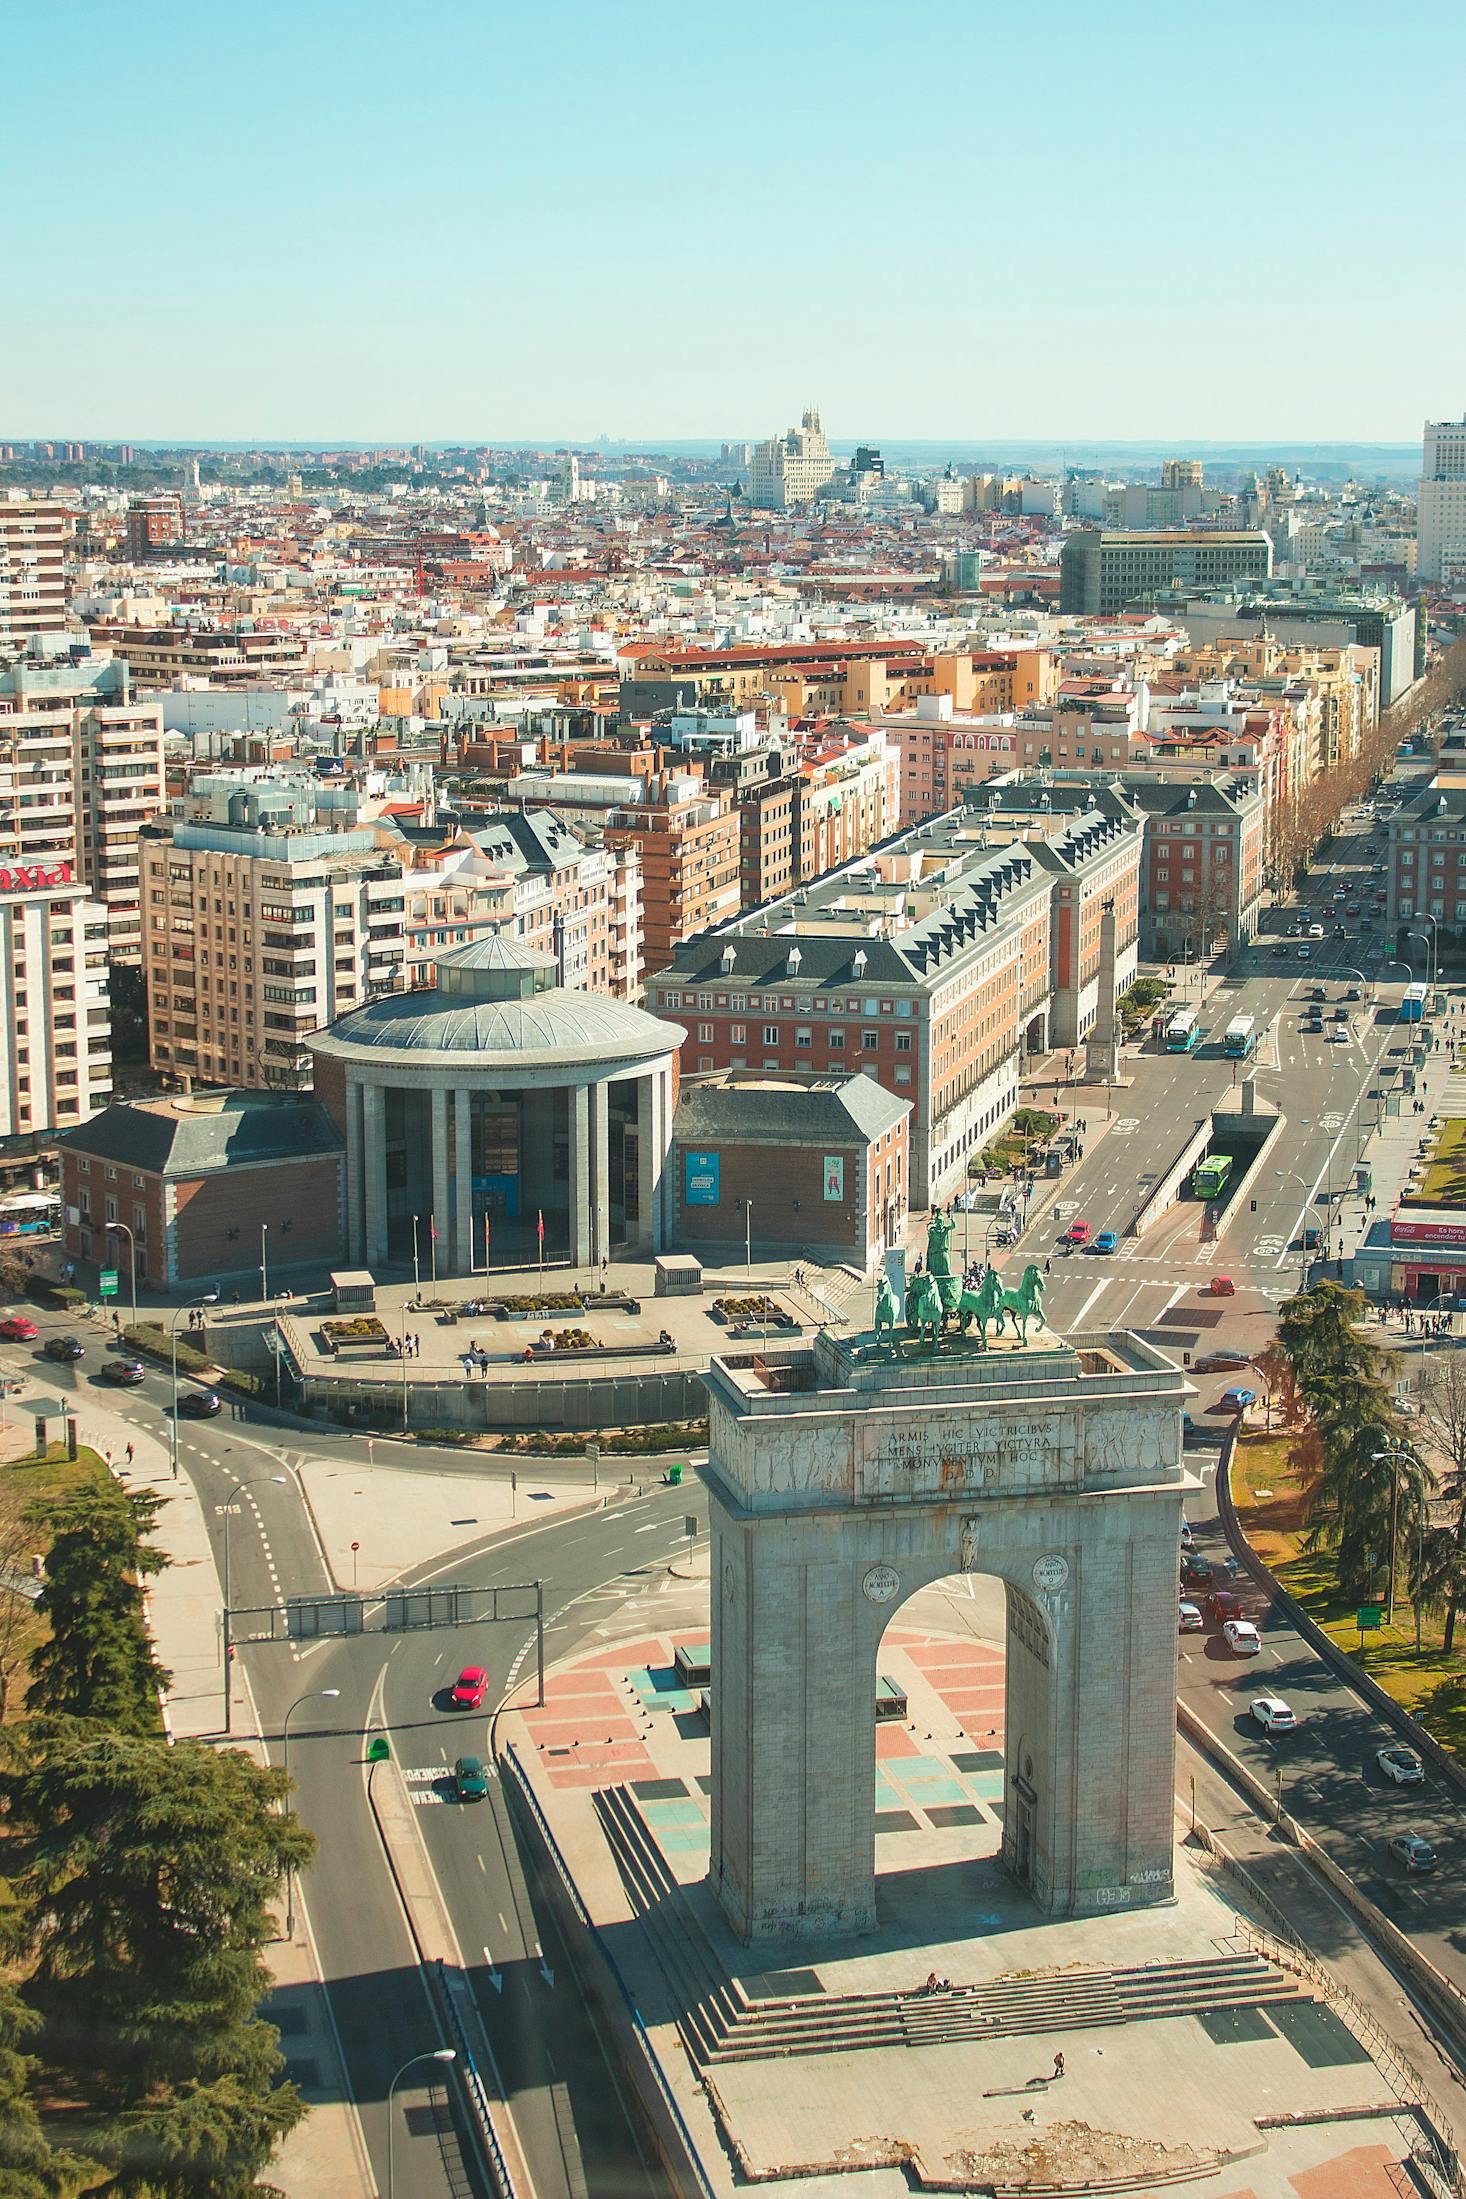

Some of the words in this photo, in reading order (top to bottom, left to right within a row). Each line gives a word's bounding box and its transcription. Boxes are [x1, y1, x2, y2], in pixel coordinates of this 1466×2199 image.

[1448, 1227, 1464, 1235] hora
[889, 1431, 929, 1442] ARMIS
[943, 1429, 963, 1439] HIC
[976, 1424, 1052, 1438] VICTRICIBVS
[888, 1445, 921, 1457] MENS
[932, 1441, 979, 1454] IVGITER
[995, 1437, 1051, 1450] VICTVRA
[902, 1454, 996, 1470] MONVMENTVM
[1010, 1451, 1037, 1463] HOC
[214, 1504, 241, 1515] BUS
